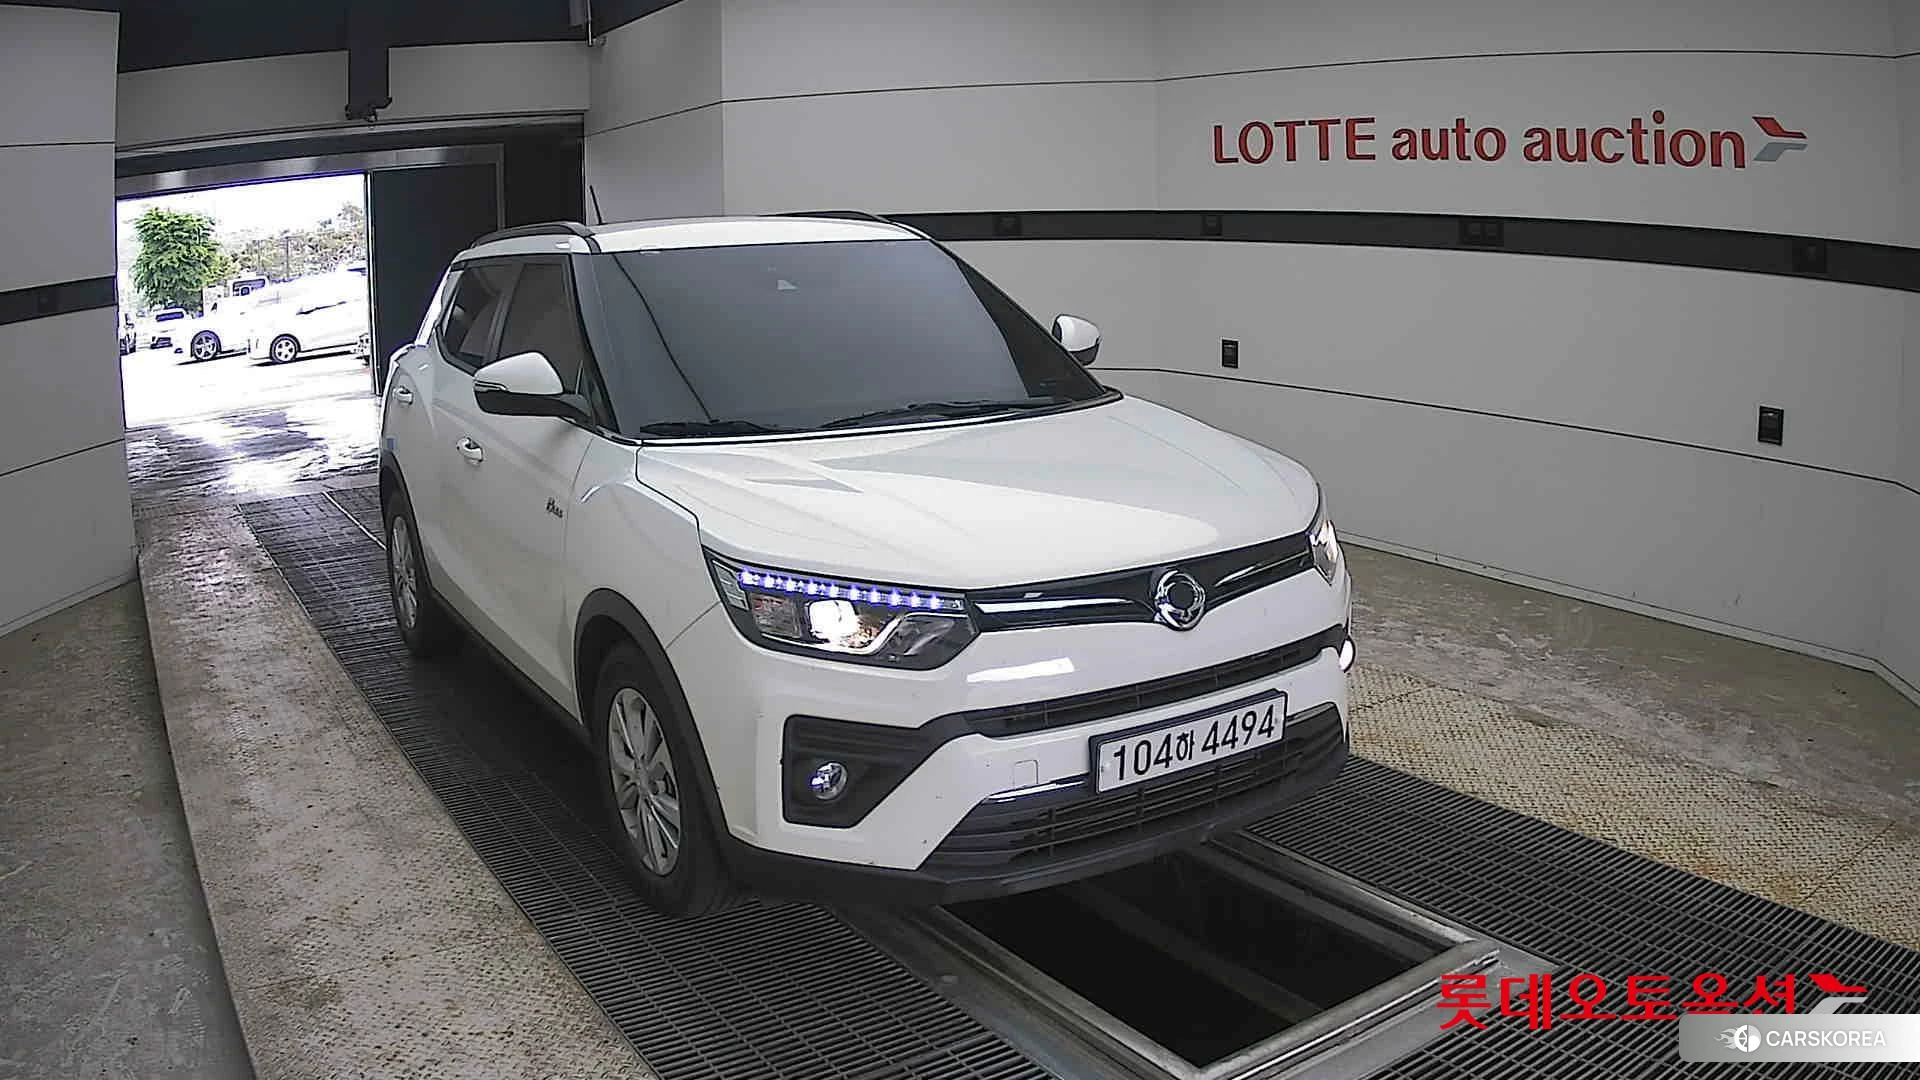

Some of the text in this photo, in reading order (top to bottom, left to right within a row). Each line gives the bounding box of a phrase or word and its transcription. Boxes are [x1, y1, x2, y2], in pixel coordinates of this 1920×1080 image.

[1214, 110, 1746, 169] LOTTE auto auction
[1113, 704, 1275, 780] 104하 4494
